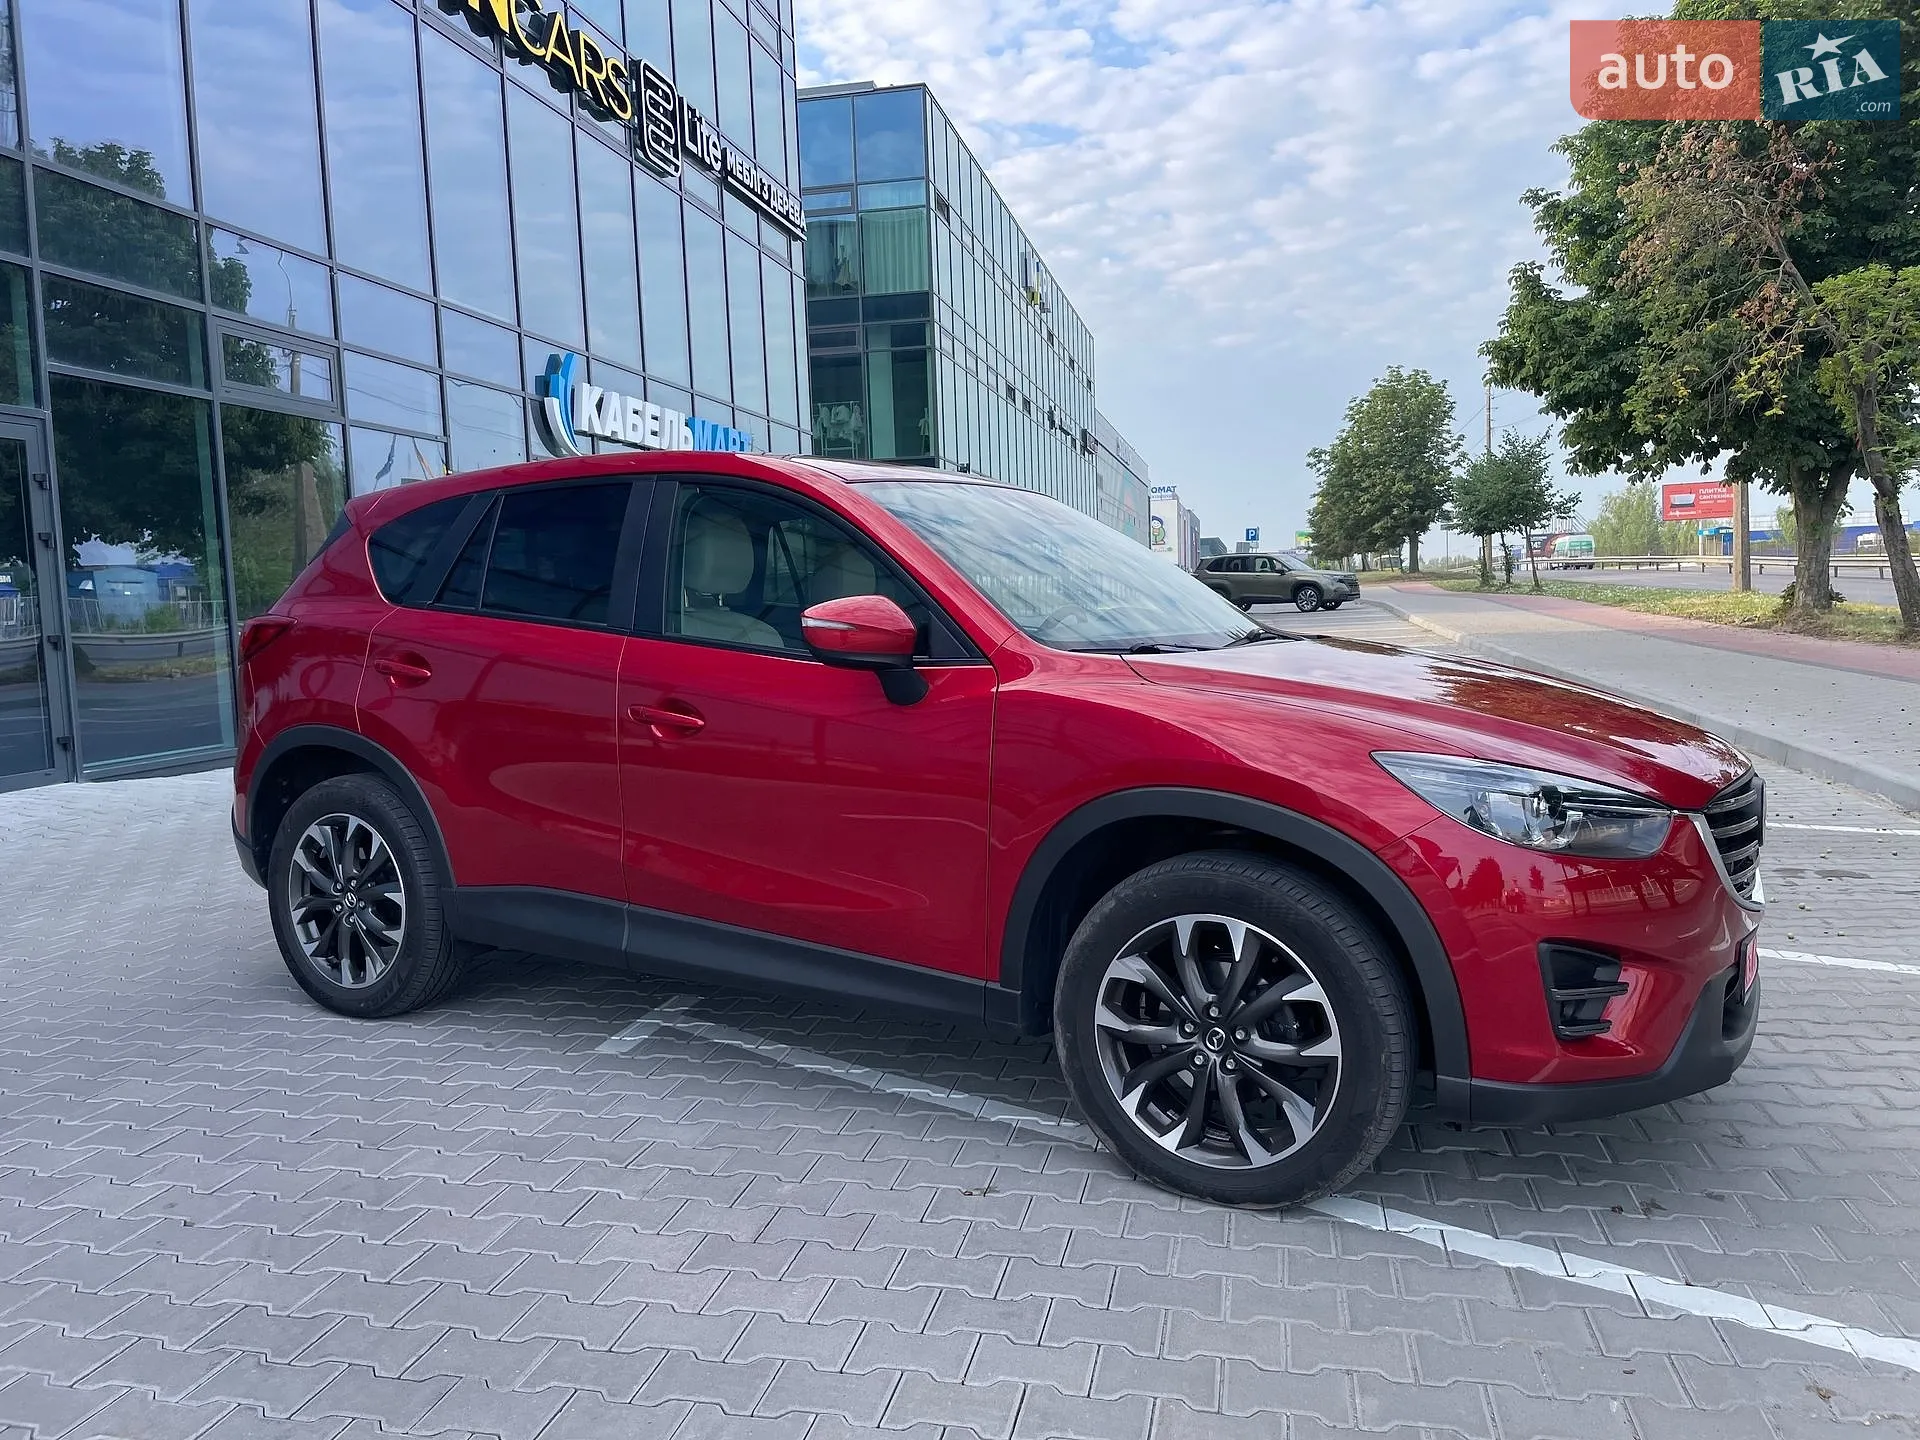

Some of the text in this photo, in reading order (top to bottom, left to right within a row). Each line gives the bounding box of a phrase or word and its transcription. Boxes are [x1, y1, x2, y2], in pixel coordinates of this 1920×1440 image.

[682, 96, 722, 172] Lite
[726, 147, 762, 195] МЕБЛІ
[770, 187, 808, 232] ДЕРЕВА
